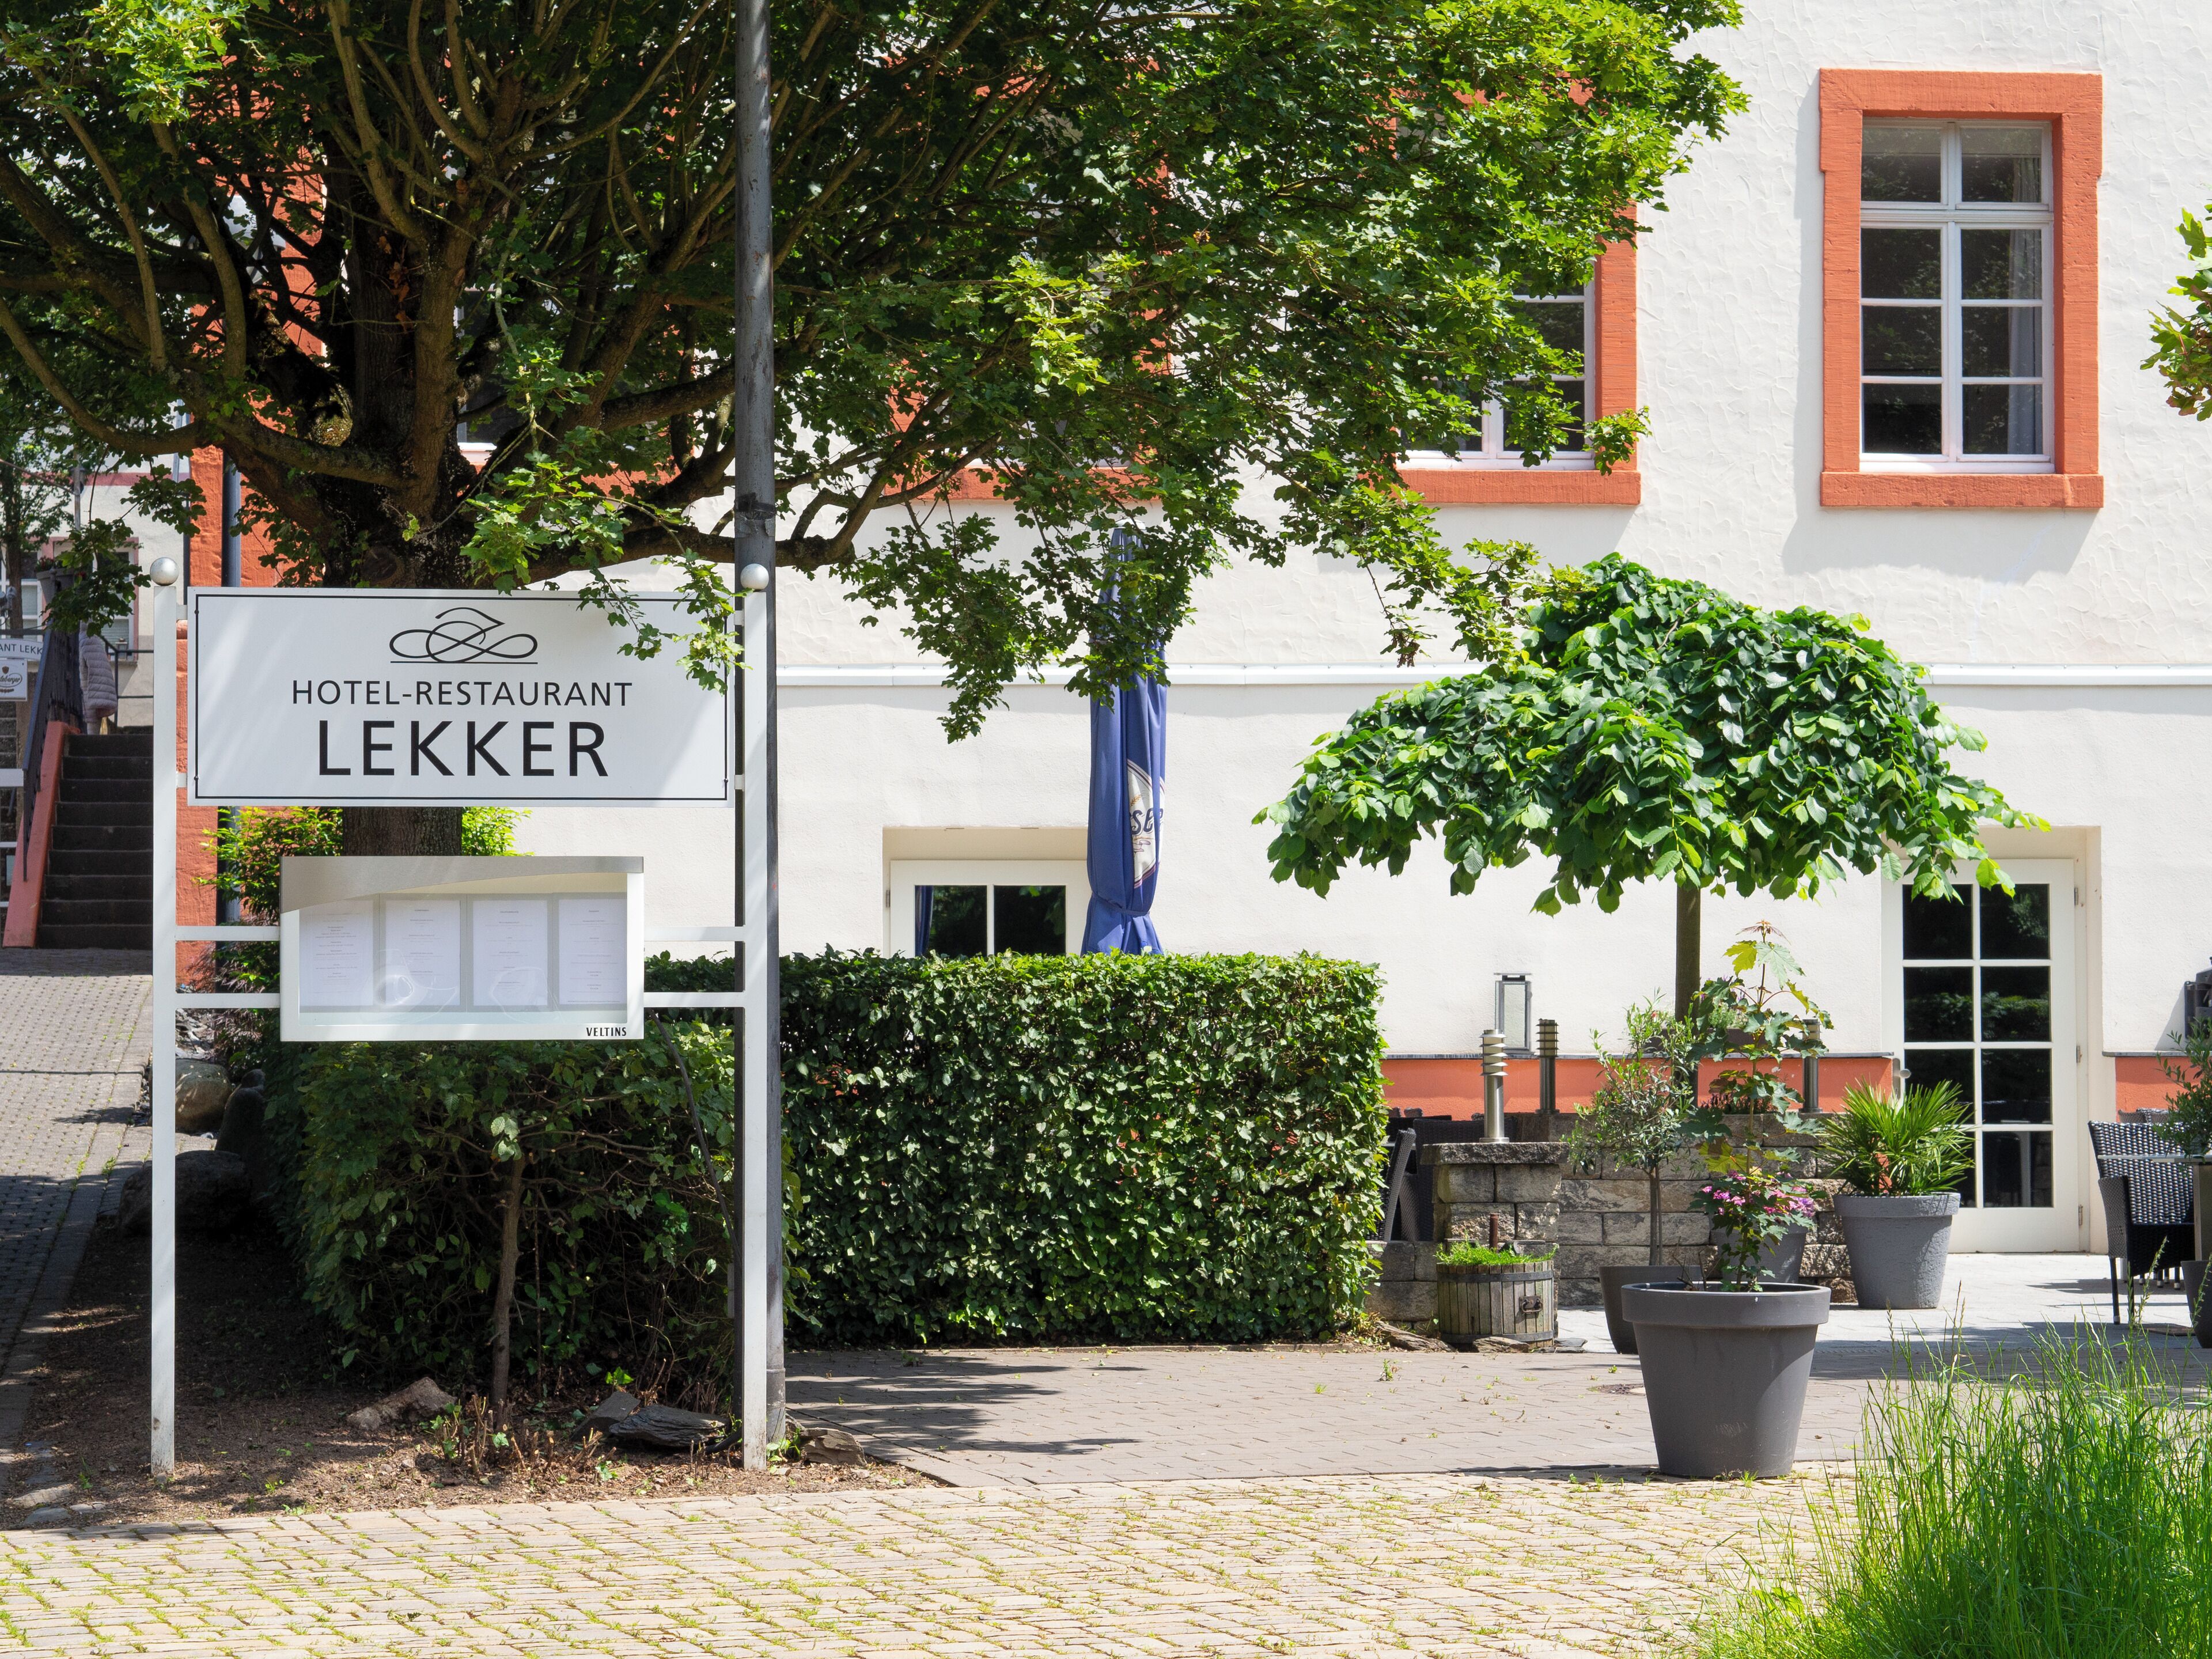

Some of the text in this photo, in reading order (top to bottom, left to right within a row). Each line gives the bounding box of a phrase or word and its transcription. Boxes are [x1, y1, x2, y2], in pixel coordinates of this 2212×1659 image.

[292, 680, 633, 706] HOTEL-RESTAURANT
[319, 720, 609, 777] LEKKER
[586, 1027, 627, 1036] VELTINS
